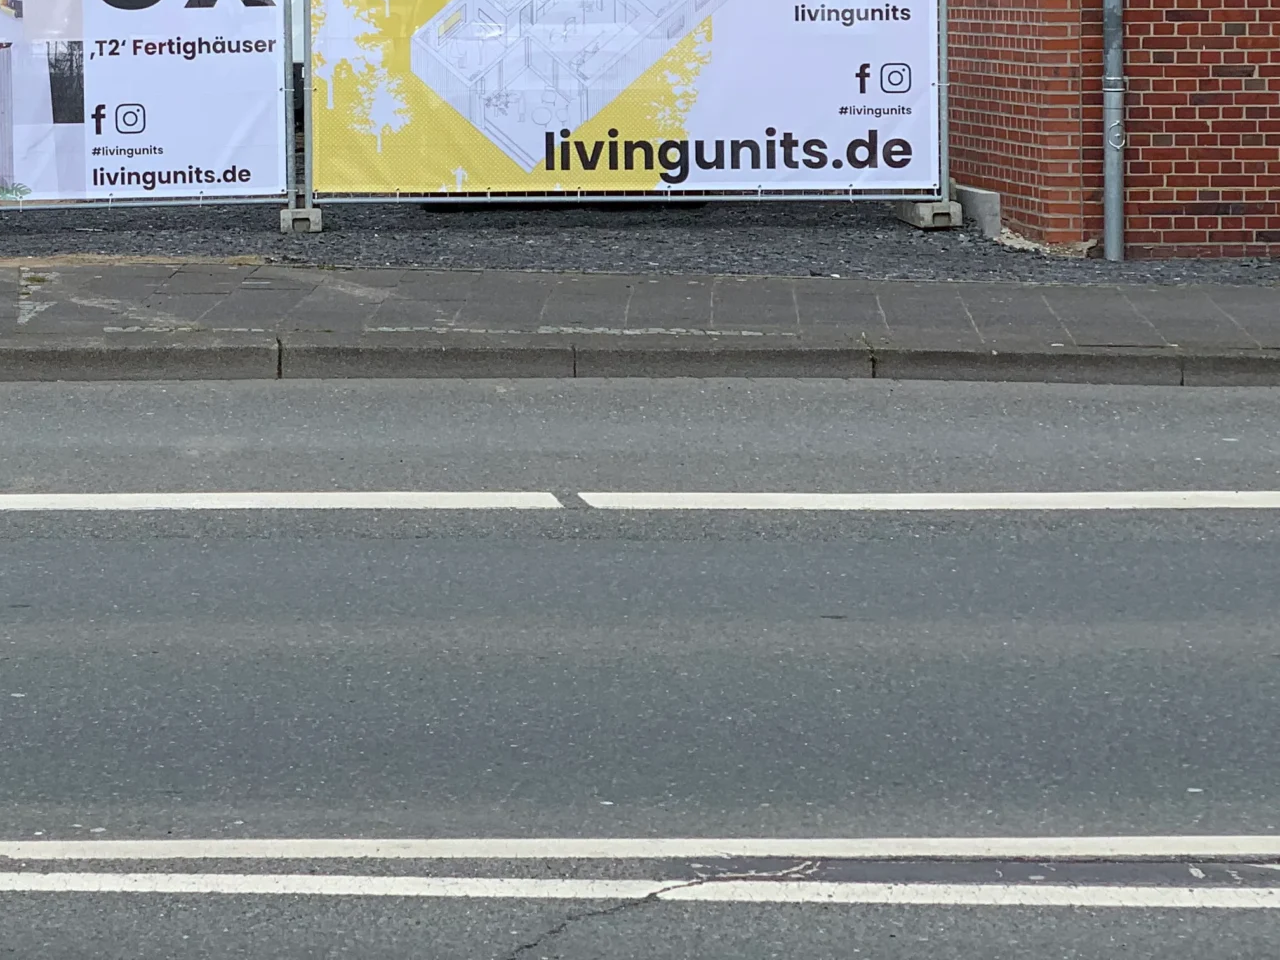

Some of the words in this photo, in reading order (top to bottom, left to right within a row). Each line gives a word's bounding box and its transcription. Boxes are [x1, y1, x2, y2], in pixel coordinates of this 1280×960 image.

[794, 3, 911, 26] livingunits
[132, 37, 276, 60] Fertighäuser
[838, 105, 912, 117] #livingunits
[91, 145, 164, 158] #livingunits
[545, 127, 913, 183] livingunits.de
[92, 165, 252, 190] livingunits.de
